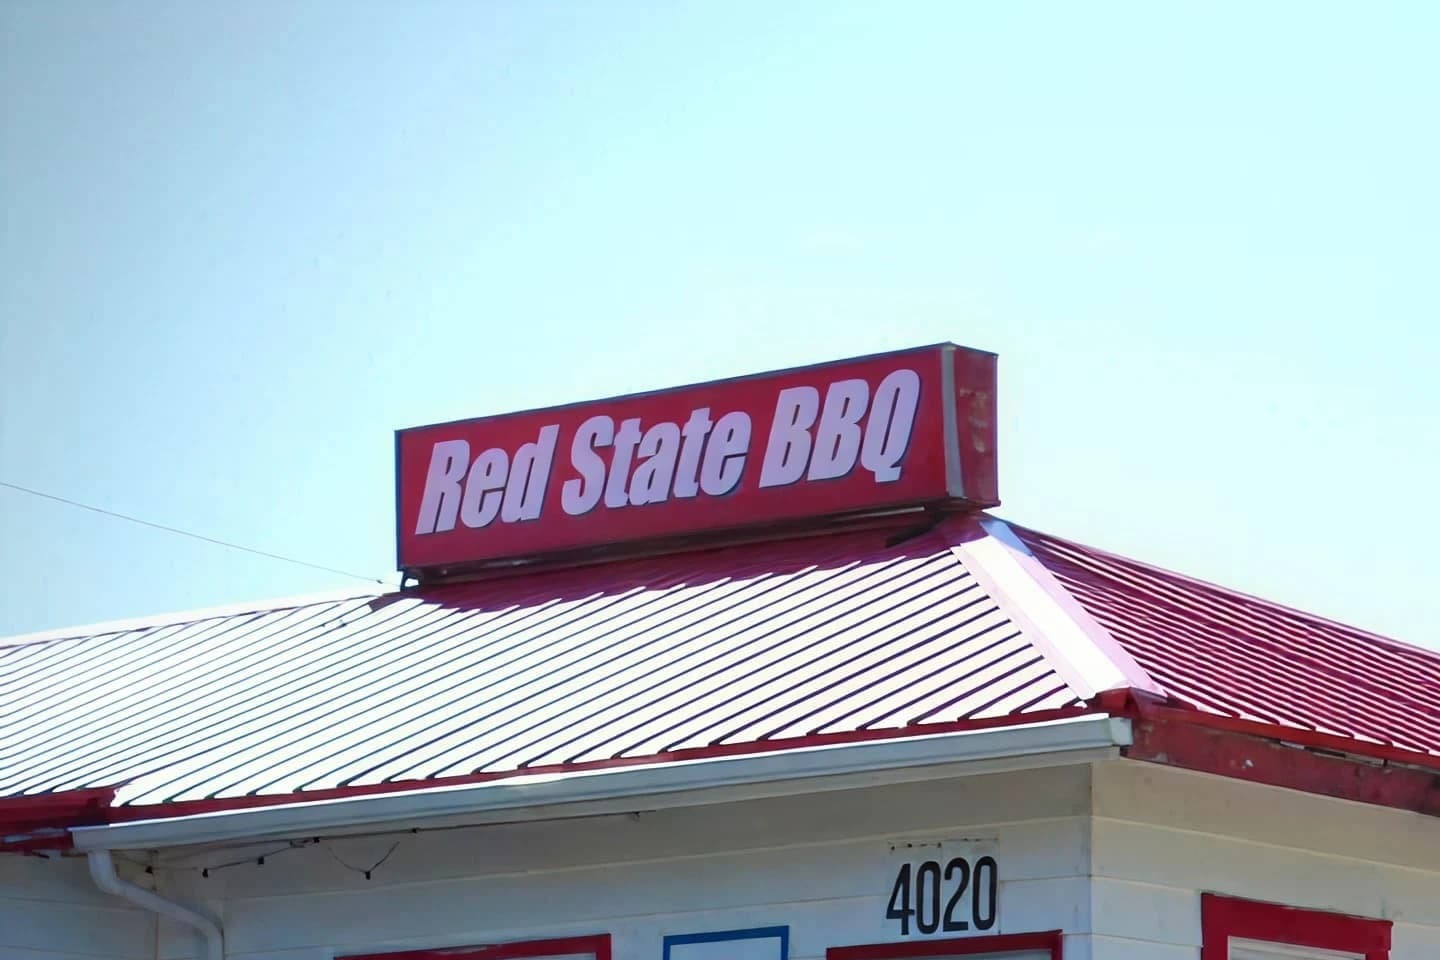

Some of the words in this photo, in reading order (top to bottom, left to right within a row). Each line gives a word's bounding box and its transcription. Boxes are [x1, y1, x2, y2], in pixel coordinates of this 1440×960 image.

[415, 424, 560, 536] Red
[561, 407, 753, 516] State
[758, 369, 922, 489] BBQ
[886, 856, 998, 935] 4020
